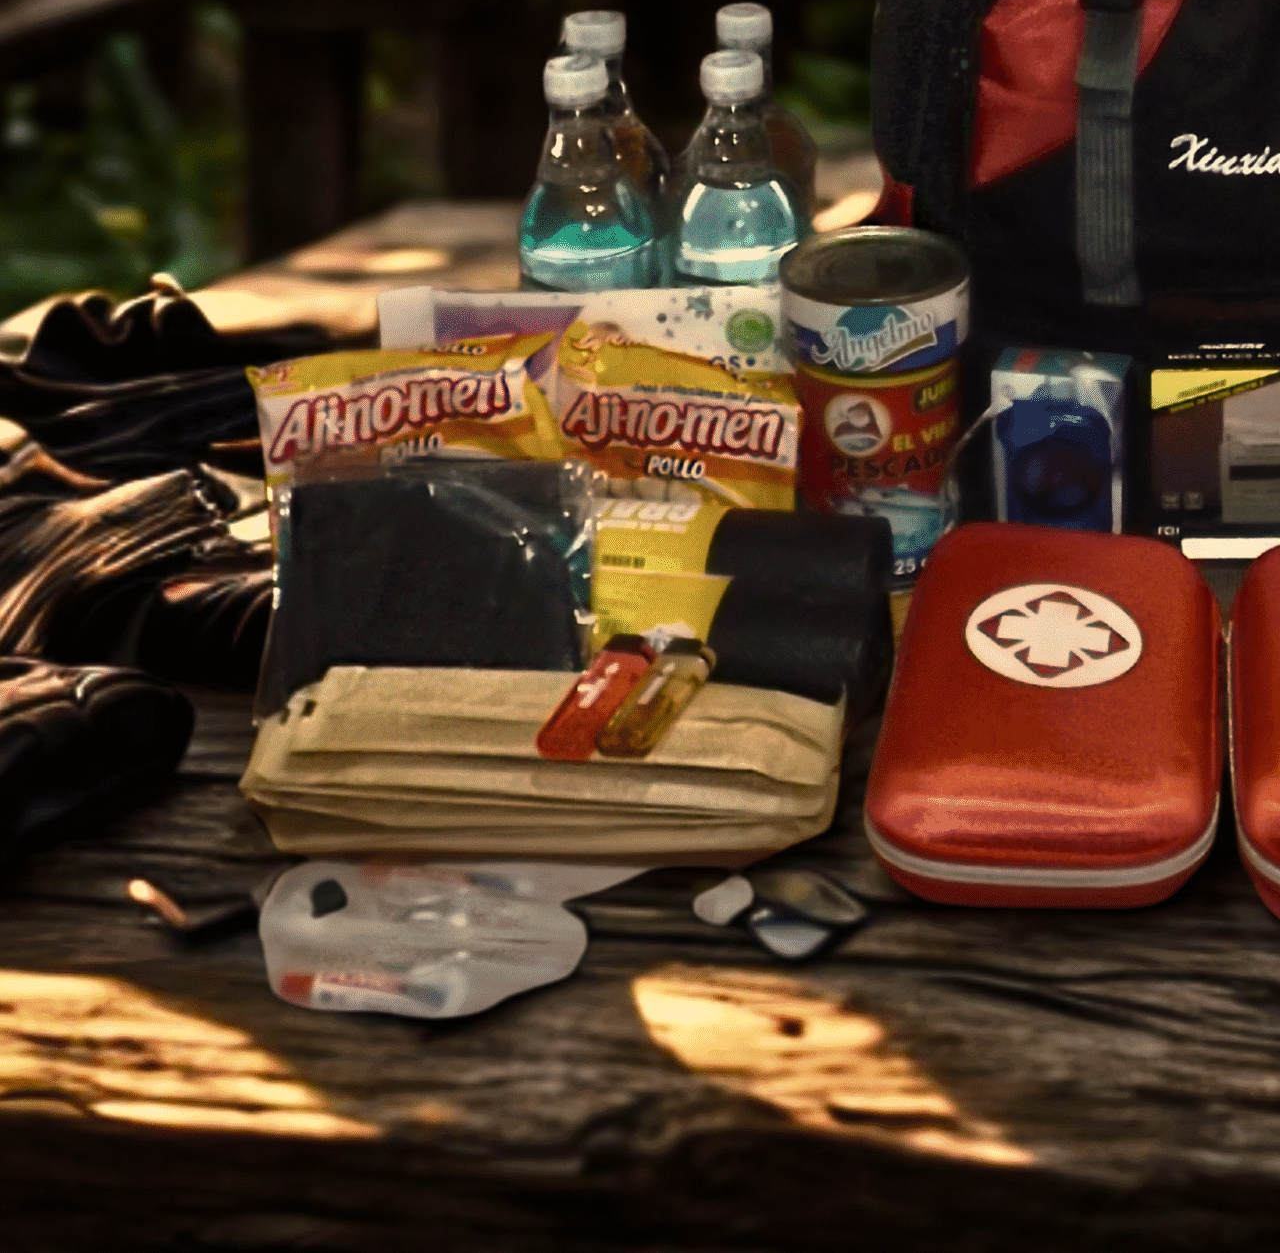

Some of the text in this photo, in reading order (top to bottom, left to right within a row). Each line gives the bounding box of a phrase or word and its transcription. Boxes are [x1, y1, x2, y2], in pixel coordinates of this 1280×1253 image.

[810, 310, 937, 371] Angelmo
[380, 430, 444, 465] POLLO
[892, 433, 916, 453] EL
[646, 454, 707, 481] POLLO
